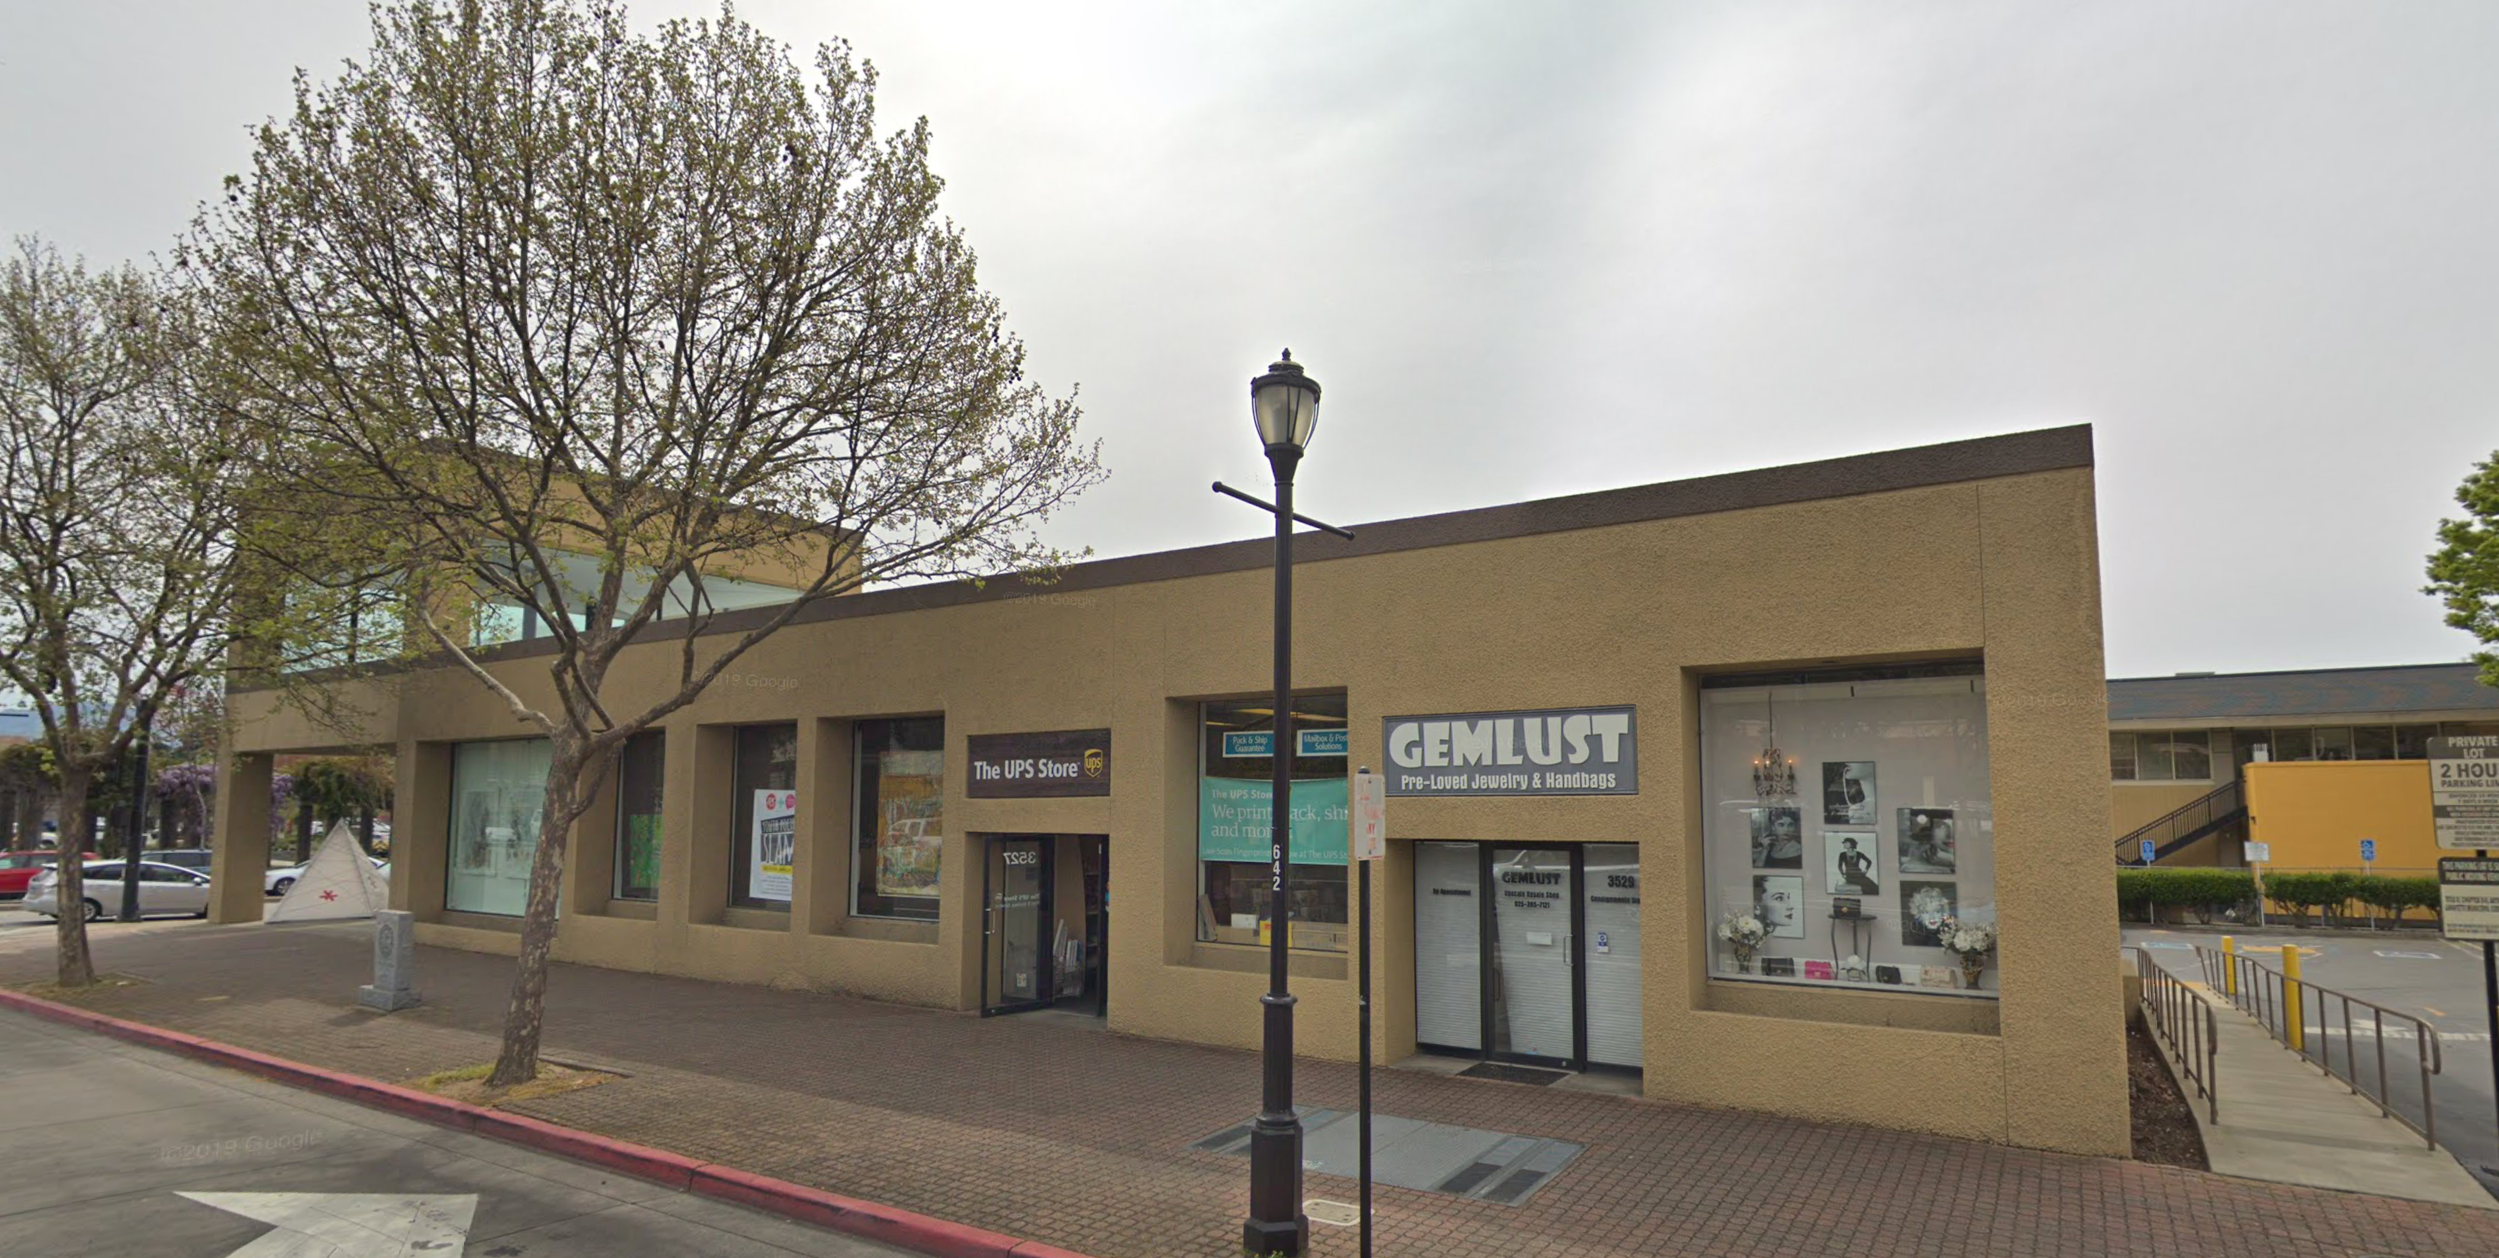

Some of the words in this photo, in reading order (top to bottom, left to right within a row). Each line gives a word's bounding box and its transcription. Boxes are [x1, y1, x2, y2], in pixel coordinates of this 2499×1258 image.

[1232, 736, 1247, 745] Pack
[1248, 736, 1254, 744] &
[1254, 735, 1268, 745] Ship
[1303, 732, 1328, 743] Mailbox
[1328, 733, 1335, 742] &
[1389, 713, 1629, 768] GEMLUST
[2447, 735, 2499, 748] PRIVATE
[1234, 744, 1266, 752] Guarantee
[1314, 742, 1343, 751] Solutions
[2463, 747, 2486, 759] LOT
[974, 761, 1001, 780] The
[1004, 759, 1035, 779] UPS
[1038, 758, 1079, 778] Store
[1086, 757, 1102, 773] ups
[2440, 763, 2451, 778] 2
[2456, 762, 2499, 778] HOU
[1401, 773, 1468, 790] Pre-Loved
[1471, 772, 1528, 790] Jewelry
[1532, 772, 1543, 788] &
[1546, 771, 1616, 789] Handbags
[2441, 779, 2484, 787] PARKING
[1212, 789, 1228, 799] The
[1229, 789, 1249, 799] UPS
[1212, 803, 1234, 819] We
[1289, 803, 1320, 822] ack,
[1324, 804, 1348, 821] shi
[1211, 822, 1239, 838] and
[1309, 850, 1321, 859] The
[1323, 850, 1339, 859] UPS
[1502, 871, 1561, 885] GEMLUST
[1607, 875, 1635, 888] 3529
[1504, 889, 1525, 898] Upscale
[1526, 890, 1544, 898] Resale
[1545, 891, 1560, 899] Shop
